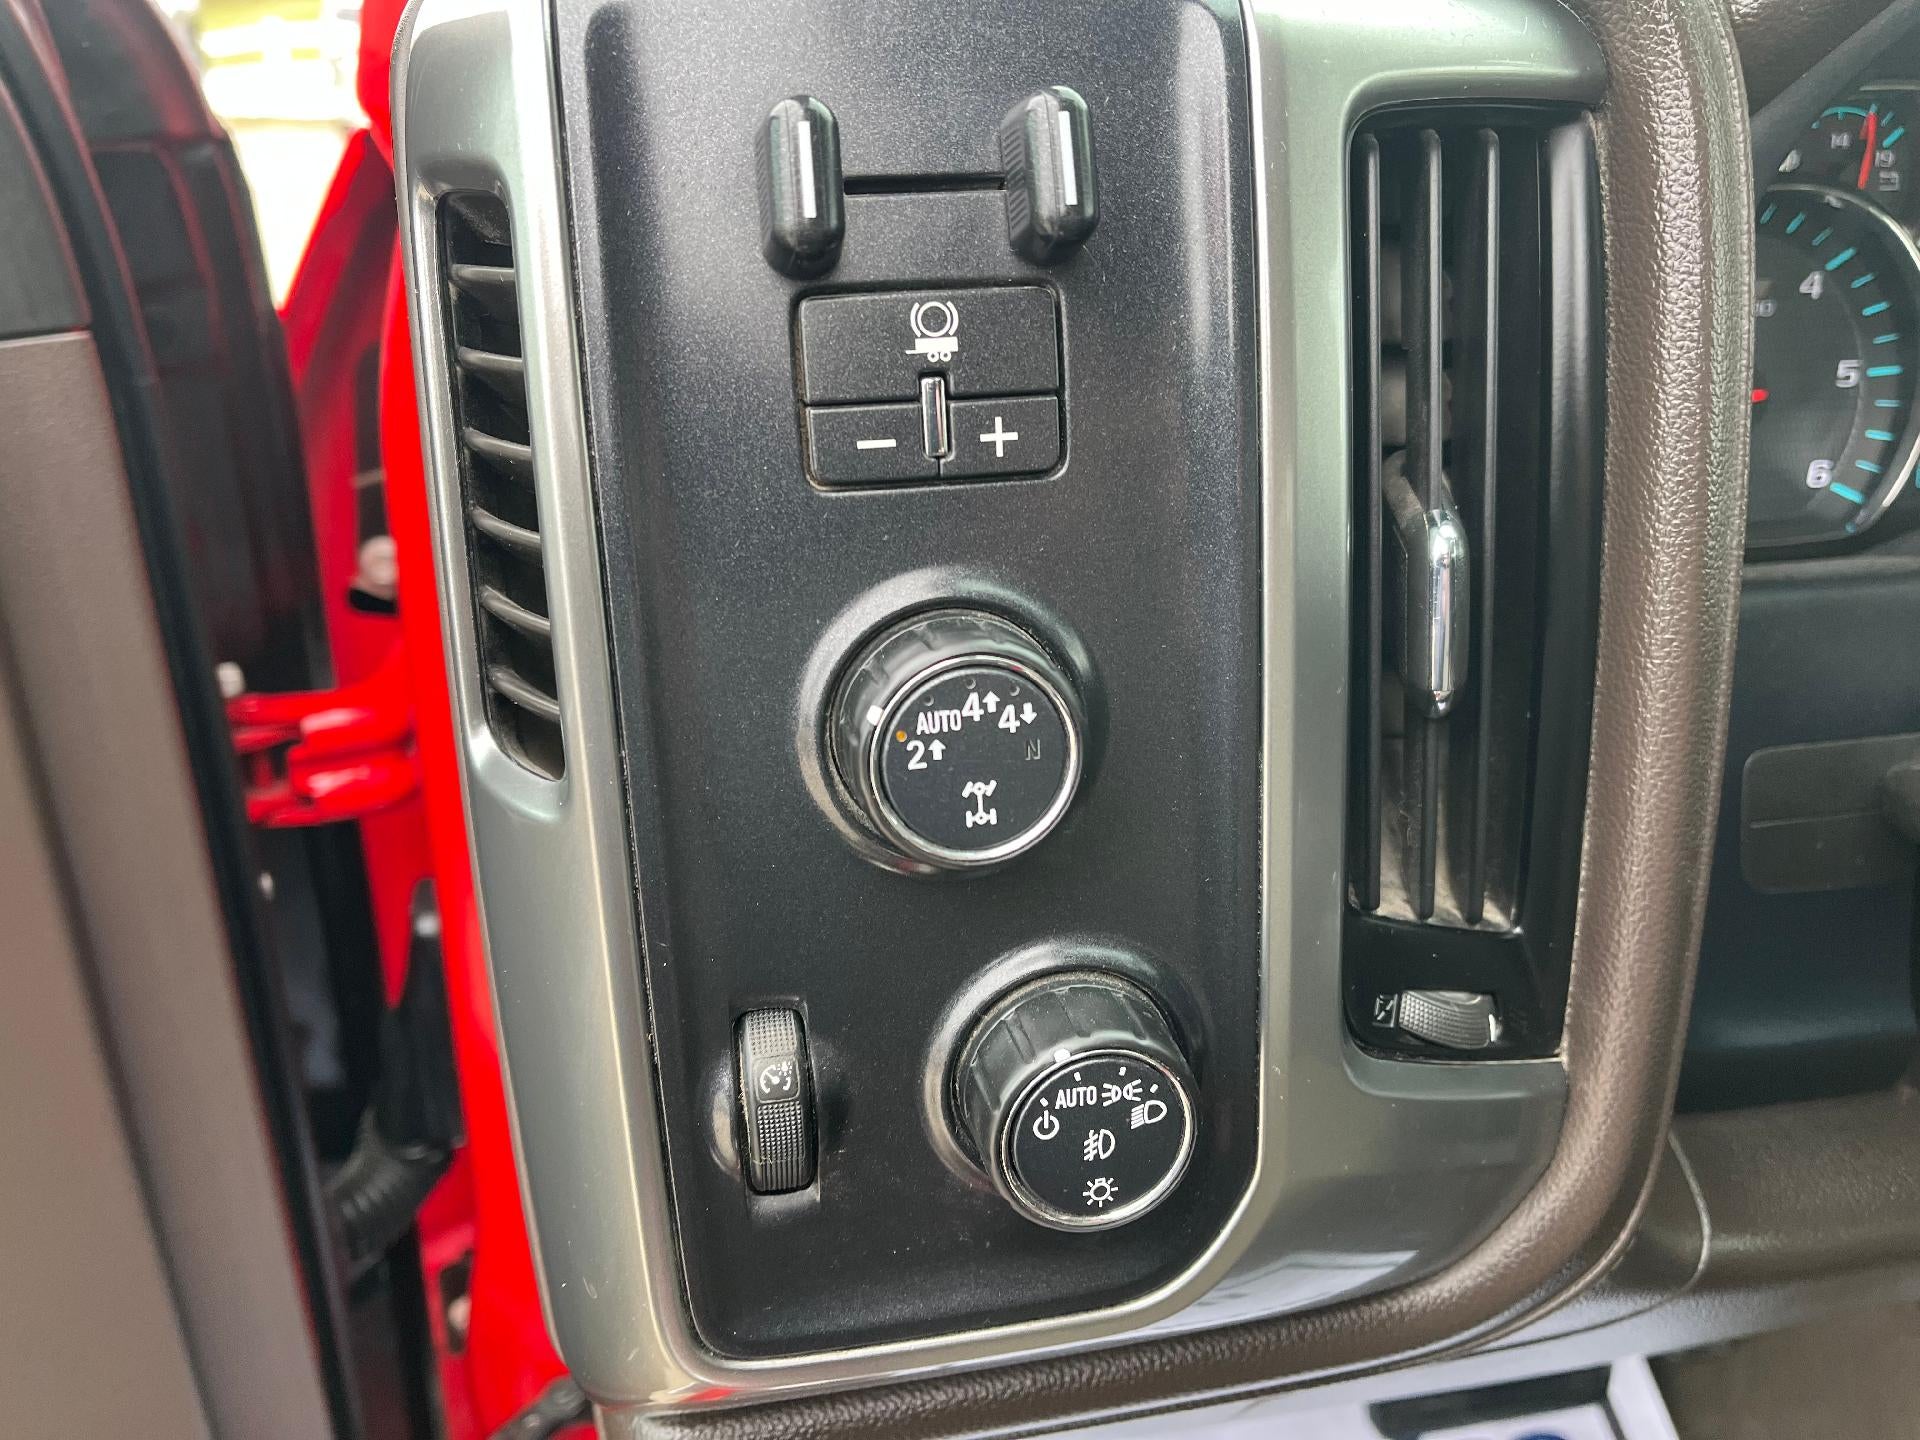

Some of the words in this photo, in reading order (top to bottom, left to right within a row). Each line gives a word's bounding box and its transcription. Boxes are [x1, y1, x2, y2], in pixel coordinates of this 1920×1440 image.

[1799, 270, 1824, 300] 4
[1835, 359, 1862, 388] 5
[1806, 459, 1834, 488] 6
[961, 691, 984, 722] 4
[998, 704, 1021, 733] 4
[916, 709, 962, 735] AUTO
[906, 739, 928, 770] 2
[1024, 738, 1042, 761] N
[1054, 1085, 1097, 1109] AUTO
